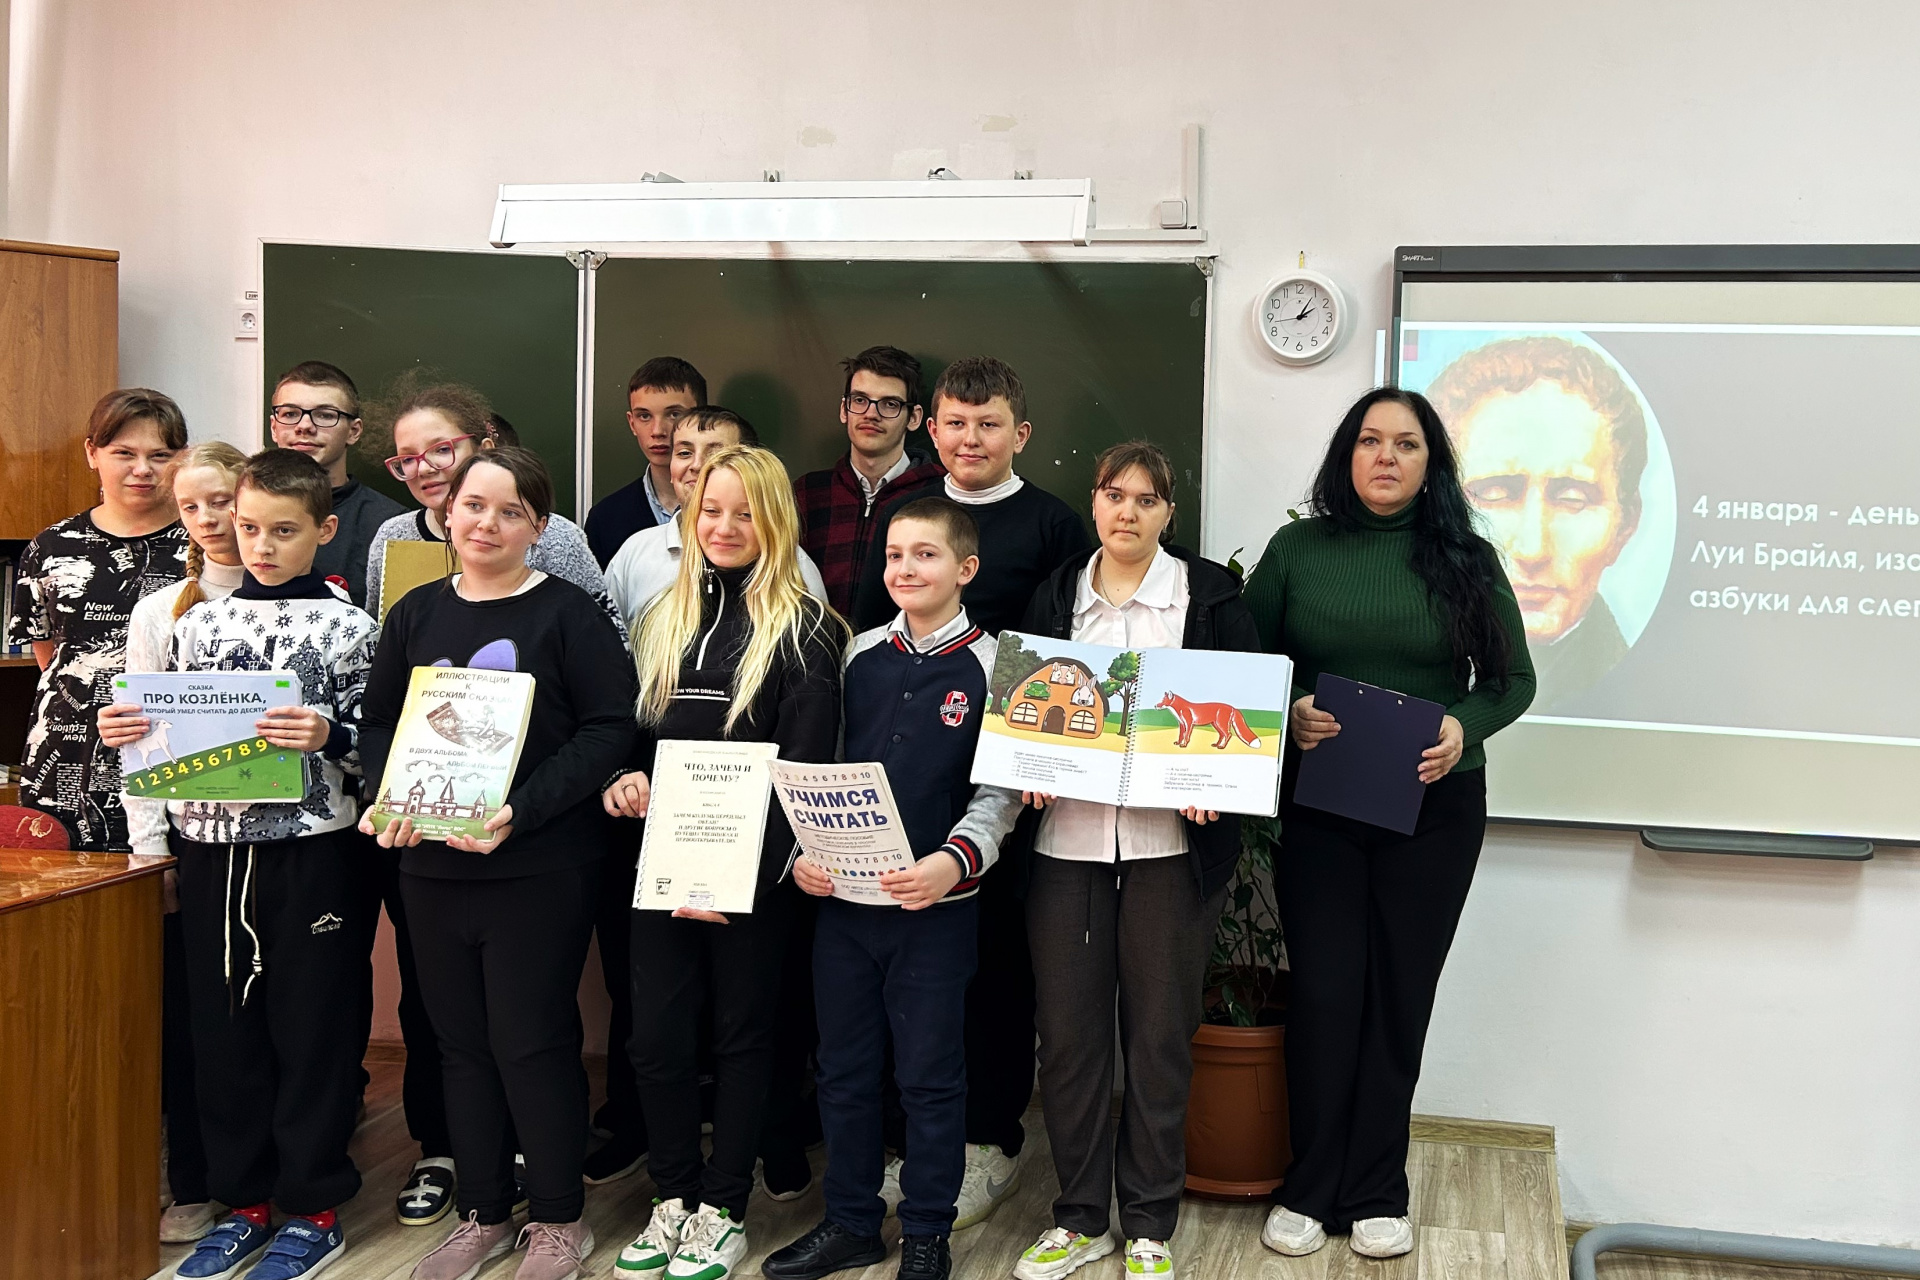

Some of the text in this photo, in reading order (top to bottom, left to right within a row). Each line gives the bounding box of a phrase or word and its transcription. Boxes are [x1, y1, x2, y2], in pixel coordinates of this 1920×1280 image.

[1283, 288, 1288, 298] 11
[1296, 284, 1304, 294] 12
[1271, 298, 1280, 309] 10
[1322, 298, 1329, 308] 2
[1267, 313, 1274, 323] 9
[1326, 312, 1333, 322] 3
[1271, 326, 1277, 336] 8
[1322, 326, 1328, 336] 4
[1282, 337, 1289, 347] 7
[1296, 341, 1303, 351] 6
[1311, 336, 1318, 346] 5
[1692, 495, 1709, 518] 4
[1716, 501, 1818, 526] января
[1848, 506, 1920, 526] день
[1690, 540, 1744, 569] Луи
[1754, 542, 1865, 572] Брайля,
[1689, 586, 1790, 615] азбуки
[1798, 595, 1848, 616] для
[84, 602, 114, 612] New
[84, 612, 130, 622] Edition
[436, 672, 510, 684] ИЛЛЮСТРАЦИИ
[143, 691, 267, 704] ПРО КОЗЛЁНКА,
[422, 690, 466, 699] РУССКИМ
[52, 724, 88, 734] Edition
[62, 734, 87, 742] New
[136, 778, 145, 790] 1
[149, 773, 161, 786] 2
[162, 767, 174, 779] 3
[178, 763, 189, 775] 4
[192, 758, 204, 771] 5
[208, 754, 220, 766] 6
[222, 748, 232, 761] 7
[238, 744, 251, 756] 8
[255, 739, 268, 752] 9
[684, 763, 706, 772] ЧТО,
[708, 764, 742, 772] ЗАЧЕМ
[692, 774, 740, 782] ПОЧЕМУ?
[784, 788, 880, 808] УЧИМСЯ
[794, 809, 888, 828] СЧИТАТЬ
